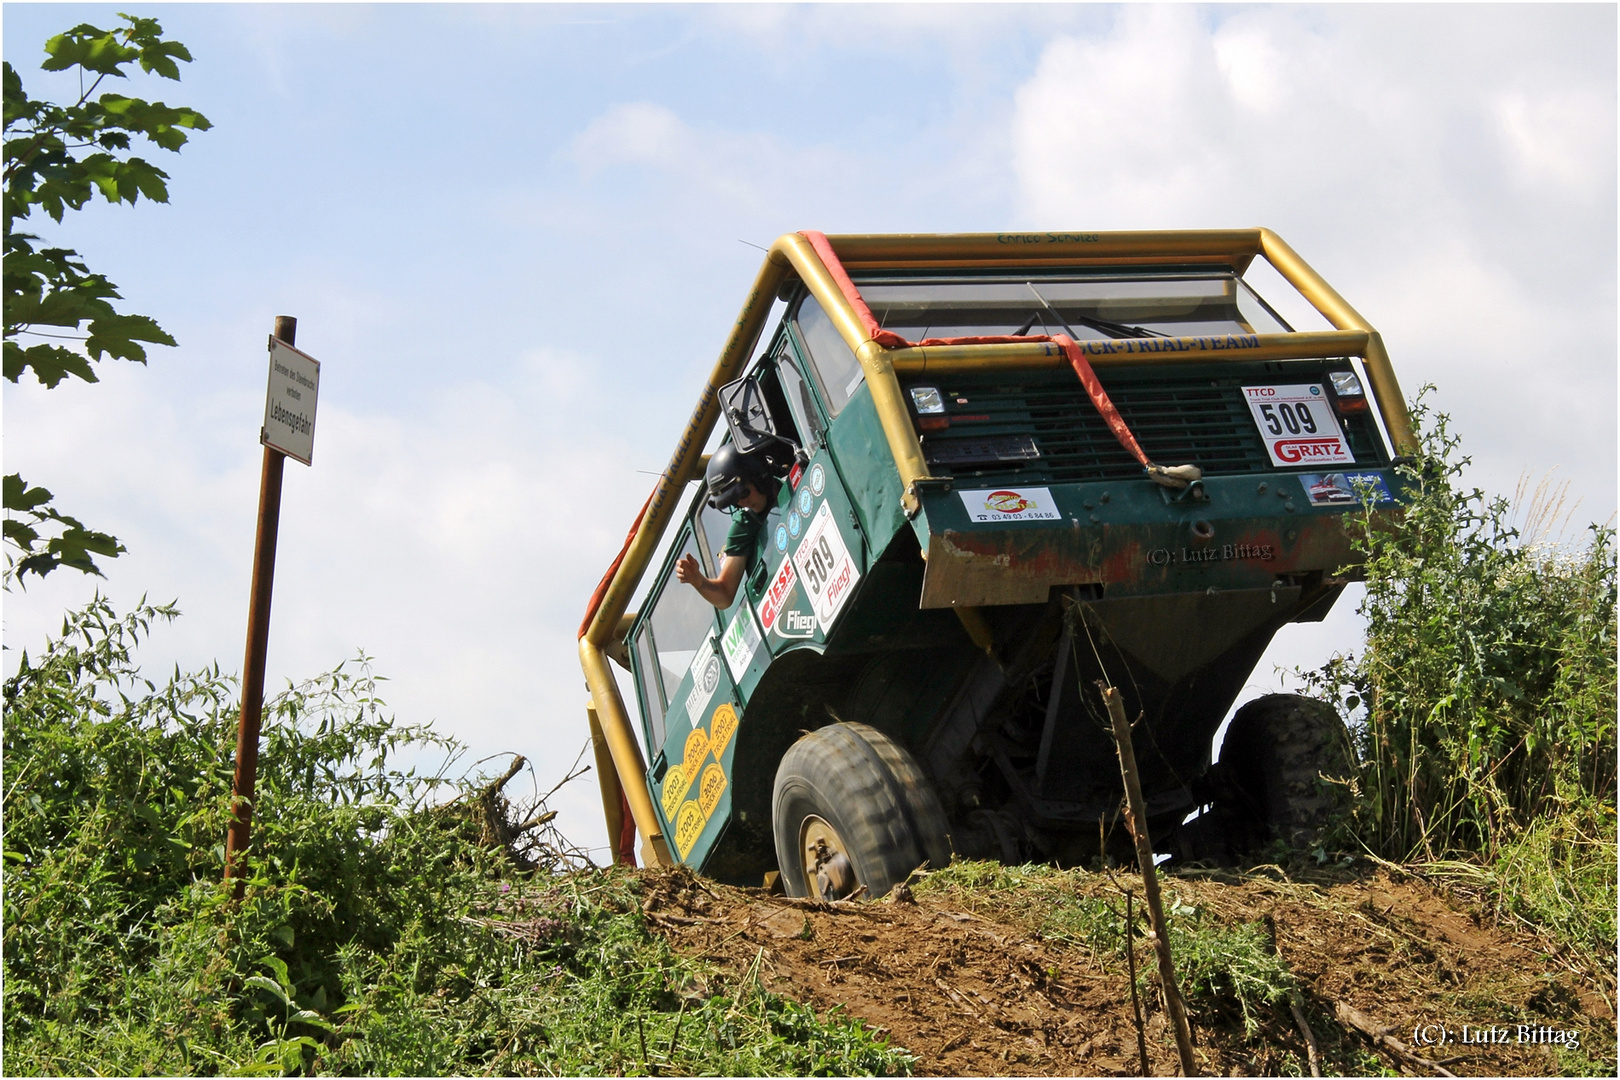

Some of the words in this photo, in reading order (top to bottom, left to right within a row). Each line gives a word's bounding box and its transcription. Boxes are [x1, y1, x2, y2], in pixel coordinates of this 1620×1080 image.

[997, 233, 1040, 244] Enrico
[1046, 232, 1099, 243] Schulze
[274, 360, 289, 377] Betreten
[296, 371, 315, 391] Steinbruchs
[286, 386, 301, 401] verboten
[1246, 388, 1275, 397] TTCD
[270, 398, 312, 436] Lebensgefahr
[1259, 402, 1317, 435] 509
[1274, 438, 1345, 463] GRÄTZ
[795, 538, 809, 564] TTCD
[804, 535, 835, 595] 509
[827, 558, 851, 607] Fliegl
[725, 617, 745, 657] LVM
[787, 610, 817, 635] Fliegl
[685, 683, 703, 712] MIETE
[713, 716, 736, 756] TRUCK-TRIAL
[714, 714, 727, 740] 2007
[686, 739, 709, 778] TRUCK-TRIAL
[688, 738, 701, 765] 2004
[665, 778, 688, 816] TRUCK-TRIAL
[666, 775, 680, 801] 2003
[702, 775, 726, 814] TRUCK-TRIAL
[703, 775, 717, 799] 2006
[680, 811, 694, 838] 2005
[680, 814, 704, 854] TRUCK-TRIAL
